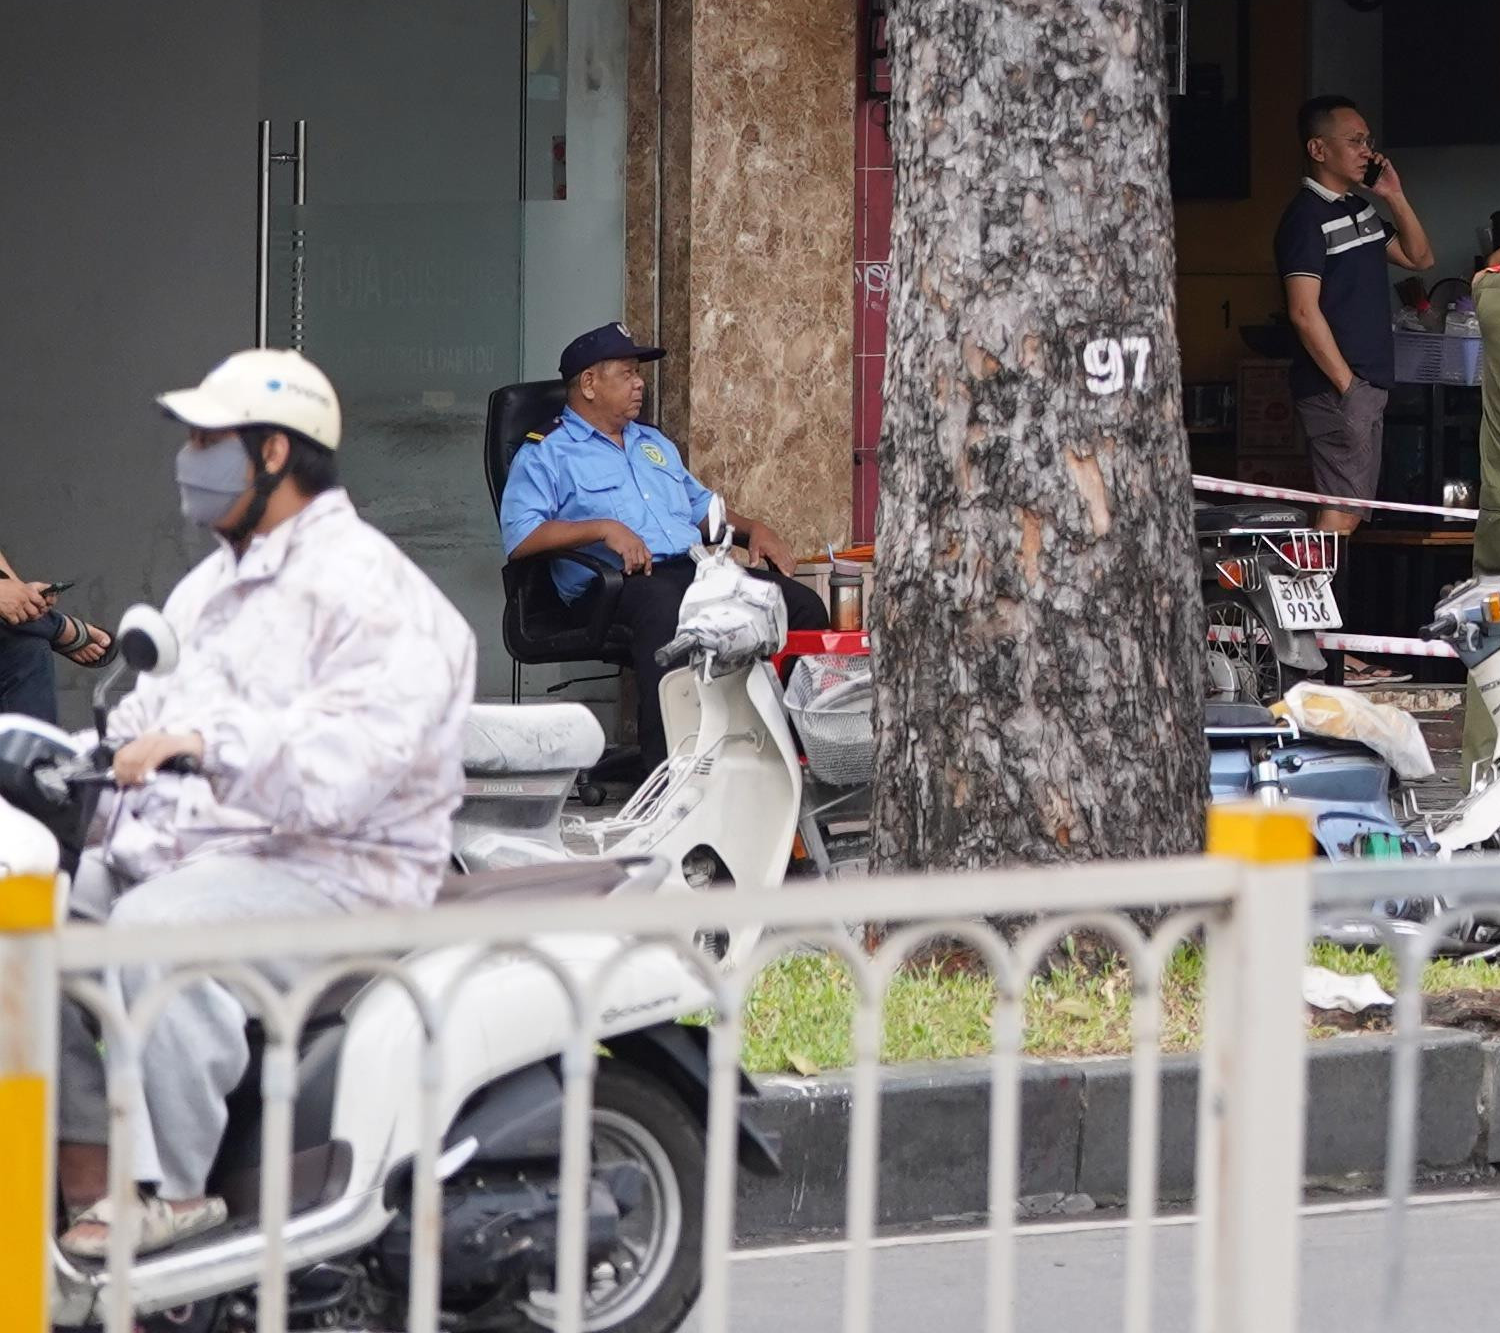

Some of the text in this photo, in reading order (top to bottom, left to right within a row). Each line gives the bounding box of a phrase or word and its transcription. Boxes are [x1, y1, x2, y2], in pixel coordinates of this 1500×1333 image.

[1084, 336, 1152, 395] 97
[1287, 602, 1331, 623] 9936
[482, 783, 525, 794] HONDA
